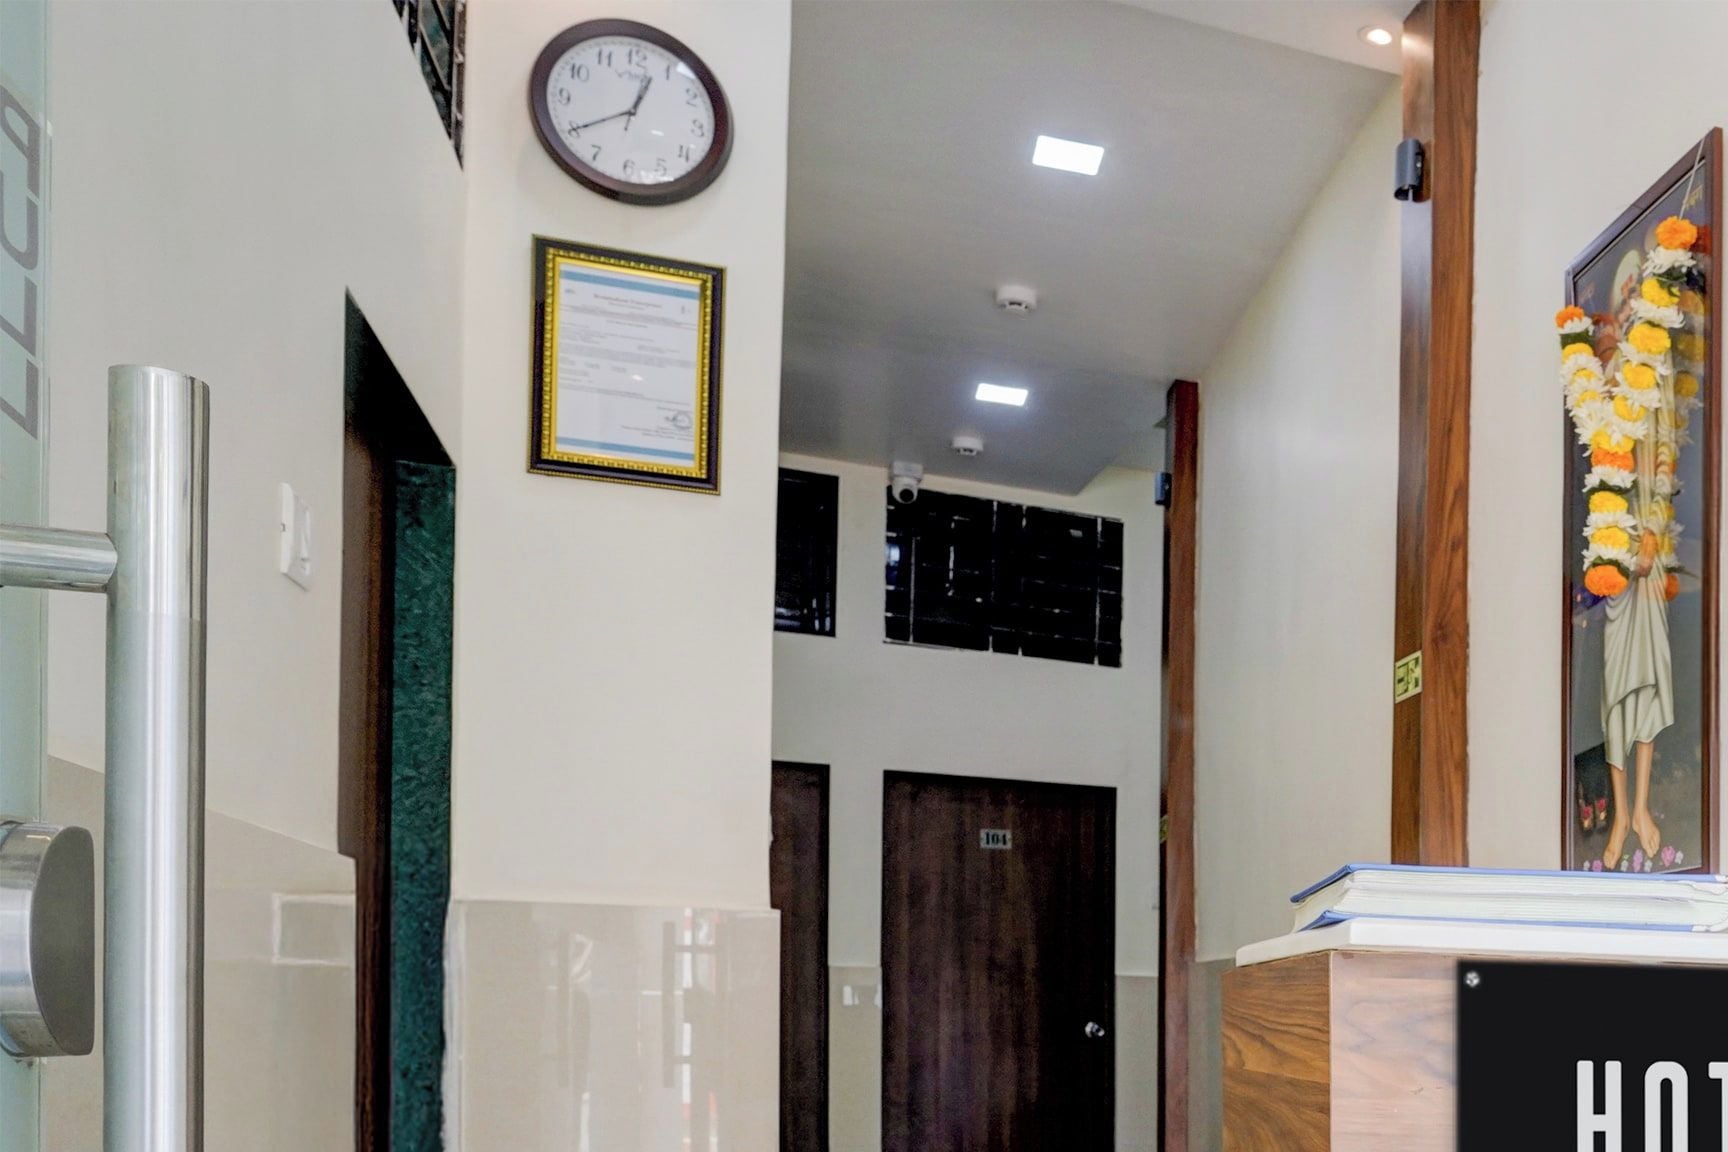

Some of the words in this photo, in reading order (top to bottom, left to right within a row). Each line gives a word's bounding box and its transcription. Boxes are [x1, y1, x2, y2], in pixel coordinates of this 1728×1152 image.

[597, 48, 612, 67] 11
[627, 48, 648, 69] 12
[571, 62, 590, 83] 10
[665, 64, 671, 81] 1
[558, 87, 571, 106] 9
[685, 88, 698, 107] 2
[690, 118, 705, 138] 3
[591, 144, 602, 161] 7
[678, 144, 690, 163] 4
[622, 158, 635, 178] 6
